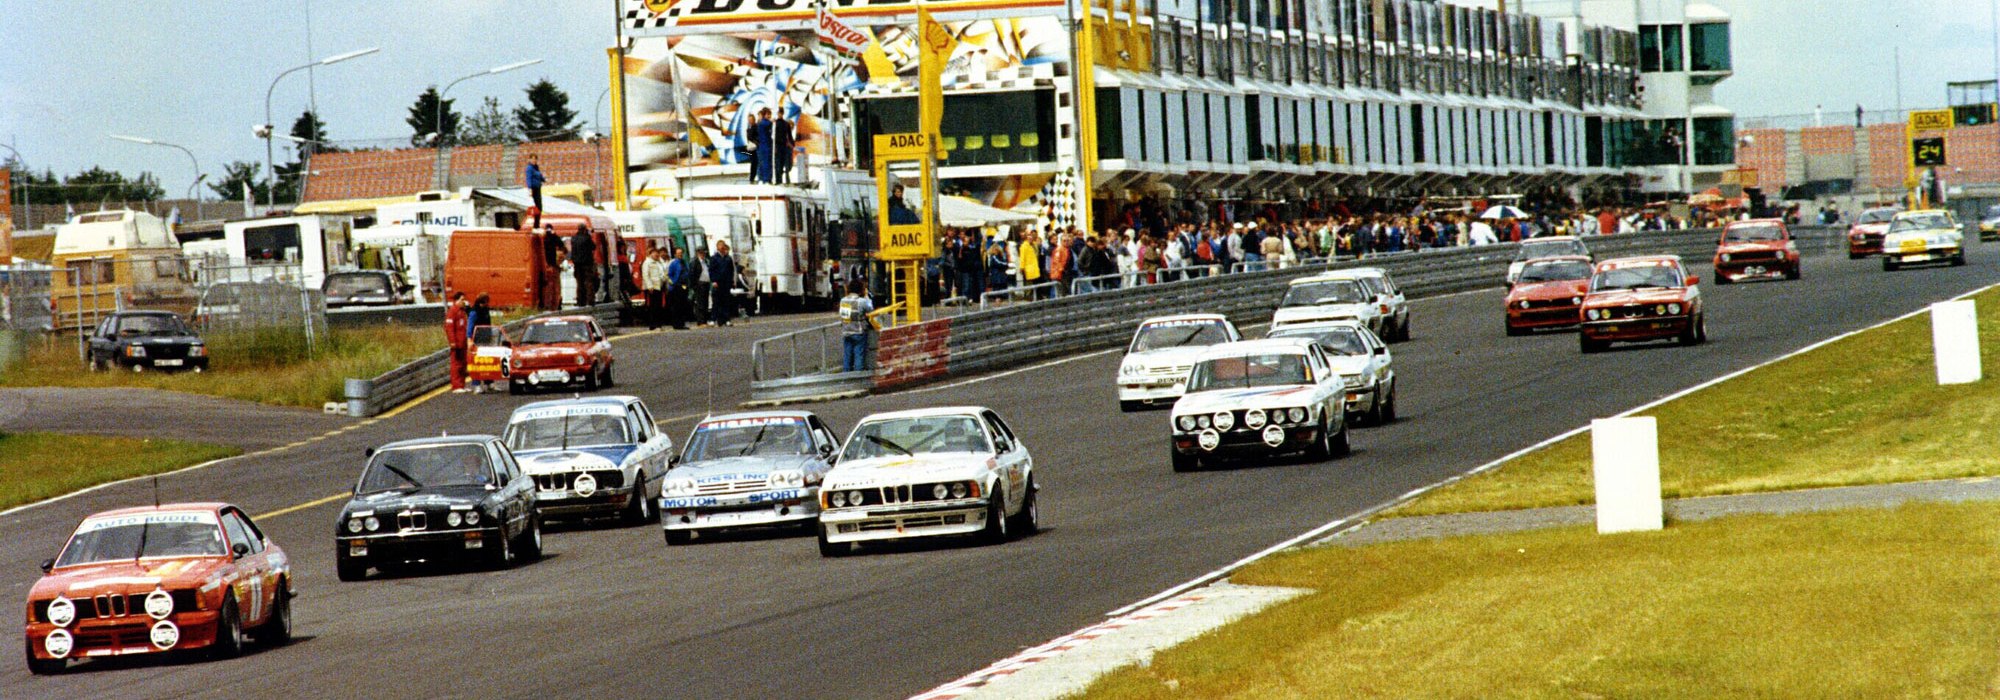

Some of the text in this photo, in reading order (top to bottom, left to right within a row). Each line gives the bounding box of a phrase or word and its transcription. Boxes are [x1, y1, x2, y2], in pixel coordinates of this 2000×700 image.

[889, 134, 925, 148] ADAC
[1918, 145, 1940, 159] 24
[891, 232, 923, 247] ADAC
[525, 406, 611, 419] AUTO BUDDE
[707, 416, 796, 430] KISSLING
[697, 472, 769, 484] KISSLING
[663, 489, 801, 509] MOTOR SPORT
[93, 513, 201, 530] AUTO BUDDE
